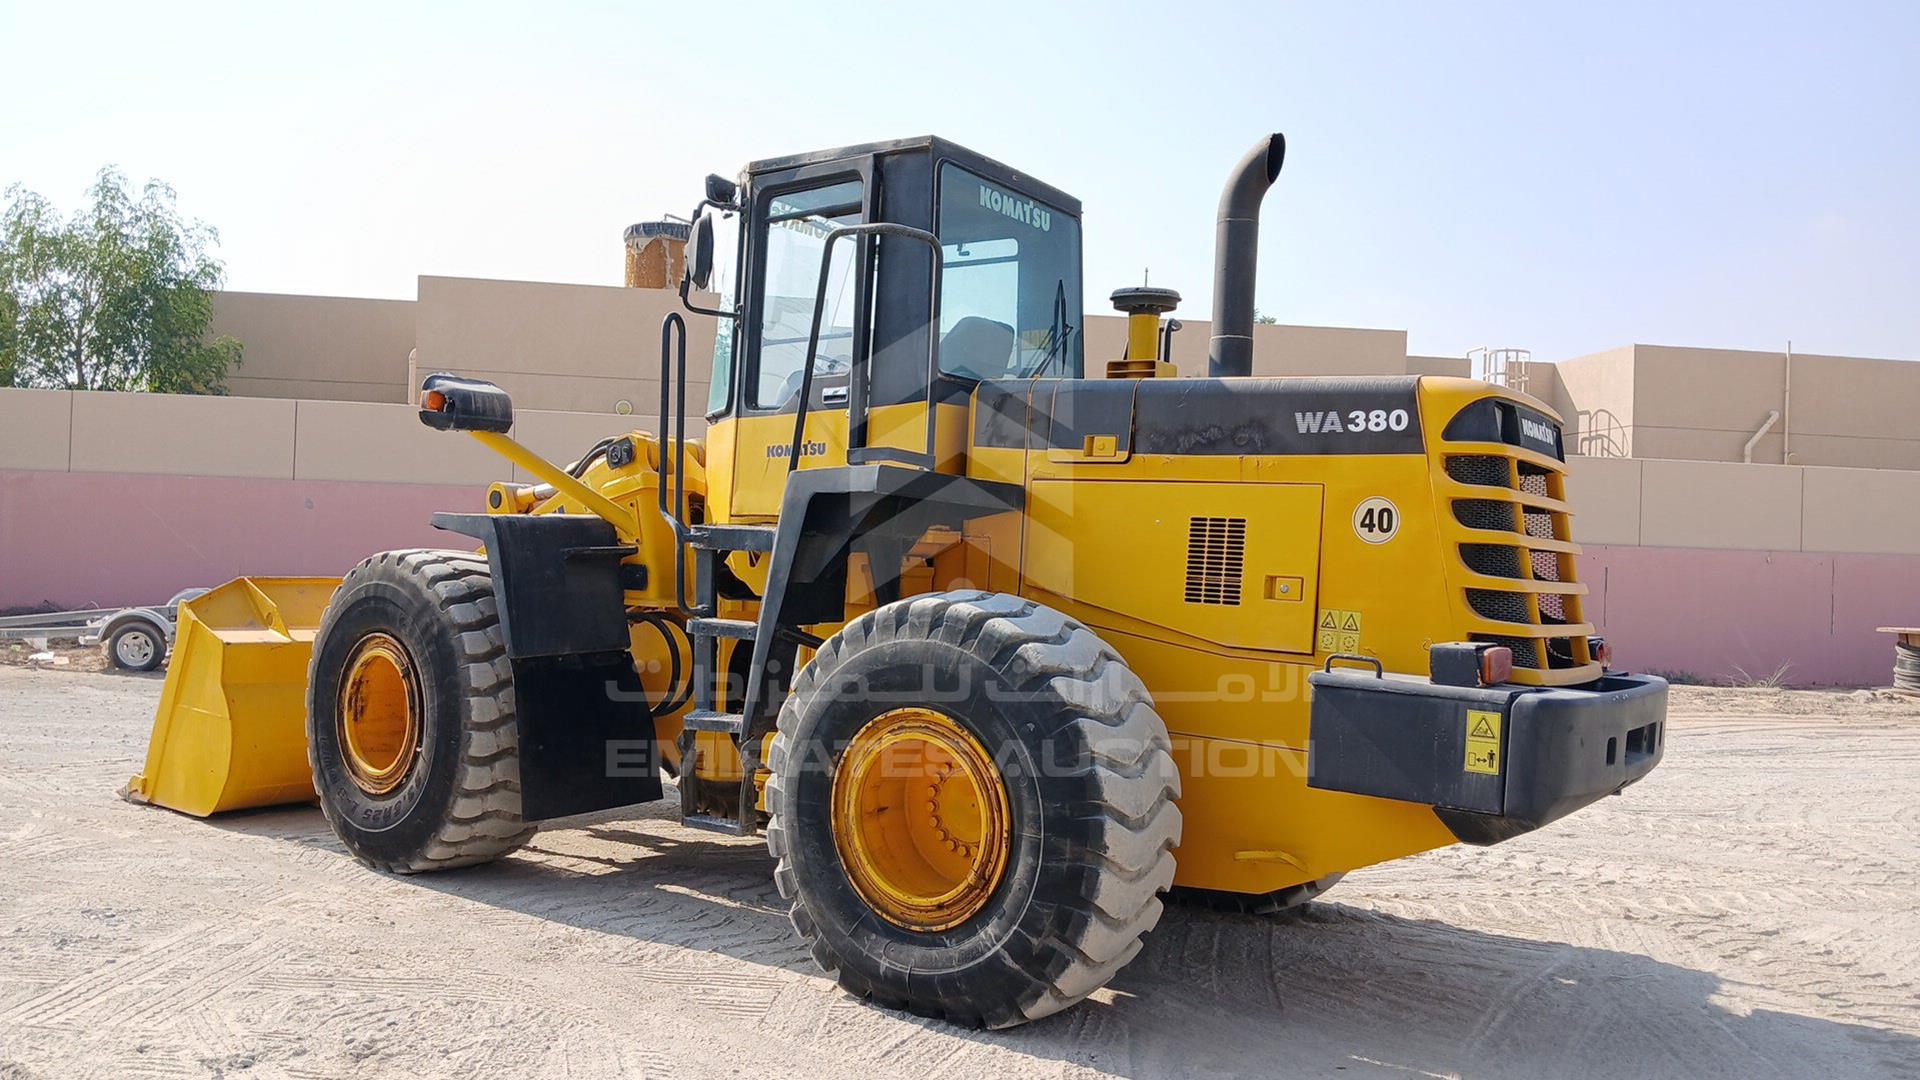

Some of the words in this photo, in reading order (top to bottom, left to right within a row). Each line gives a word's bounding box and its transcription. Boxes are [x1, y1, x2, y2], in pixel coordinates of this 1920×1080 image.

[980, 185, 1051, 231] KOMATSU
[1295, 411, 1344, 434] WA
[1347, 409, 1409, 433] 380
[1360, 507, 1393, 533] 40
